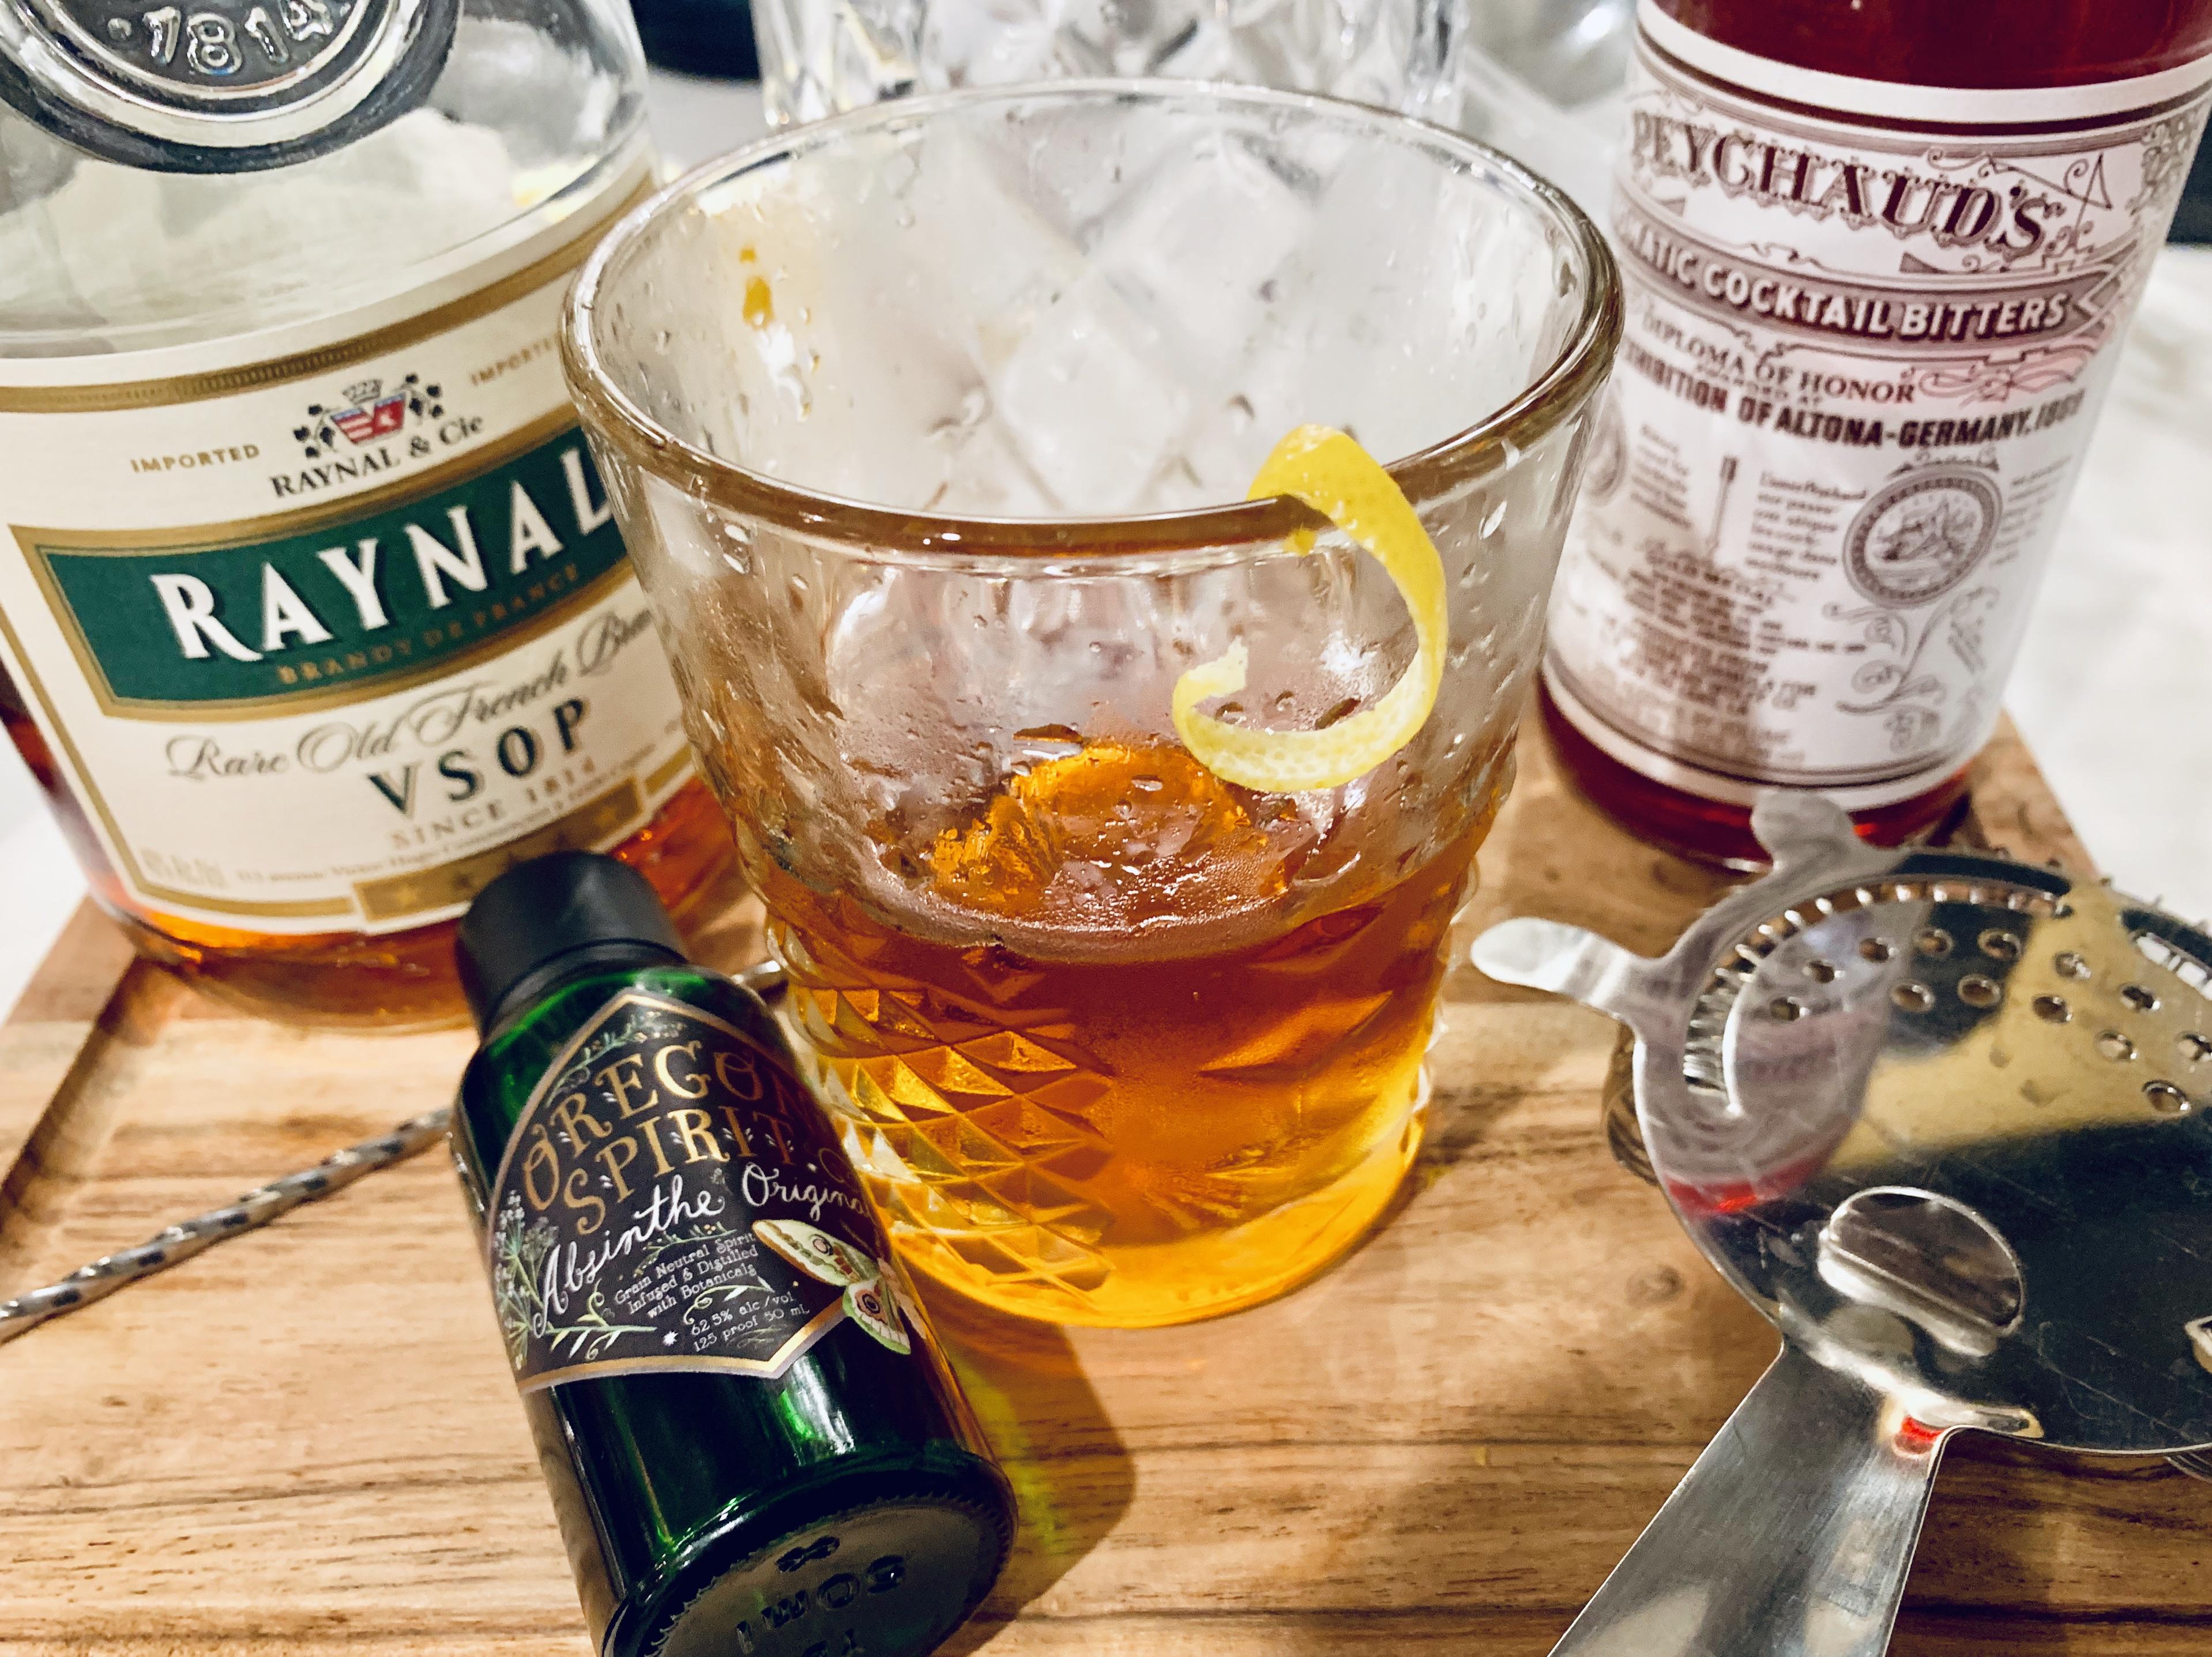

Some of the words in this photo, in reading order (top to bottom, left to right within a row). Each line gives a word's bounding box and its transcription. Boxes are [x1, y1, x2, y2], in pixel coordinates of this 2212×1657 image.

[143, 0, 334, 75] 1814
[1703, 263, 1893, 338] COCKTAIL
[1899, 291, 2067, 340] BITTERS
[1737, 396, 1772, 426] OF
[1755, 359, 1793, 385] OF
[1799, 370, 1917, 404] HONOR
[130, 443, 260, 473] IMPORTED
[269, 447, 400, 498] RAYNAL
[409, 435, 431, 459] &
[149, 446, 615, 663] RAYNAL
[276, 639, 411, 684] BRANDY
[165, 733, 289, 781] Rare
[296, 716, 394, 774] Old
[407, 649, 569, 747] French
[367, 696, 589, 820] VSOP
[390, 800, 503, 850] SINCE
[532, 1174, 726, 1339] Absinthe
[614, 1274, 653, 1305] Grain
[656, 1244, 710, 1279] Neutral
[628, 1274, 678, 1315] Infused
[697, 1244, 759, 1274] Distilled
[646, 1296, 677, 1319] with
[681, 1263, 758, 1300] Botanicals
[693, 1332, 718, 1353] 125
[722, 1316, 759, 1341] proof
[763, 1306, 785, 1323] 50
